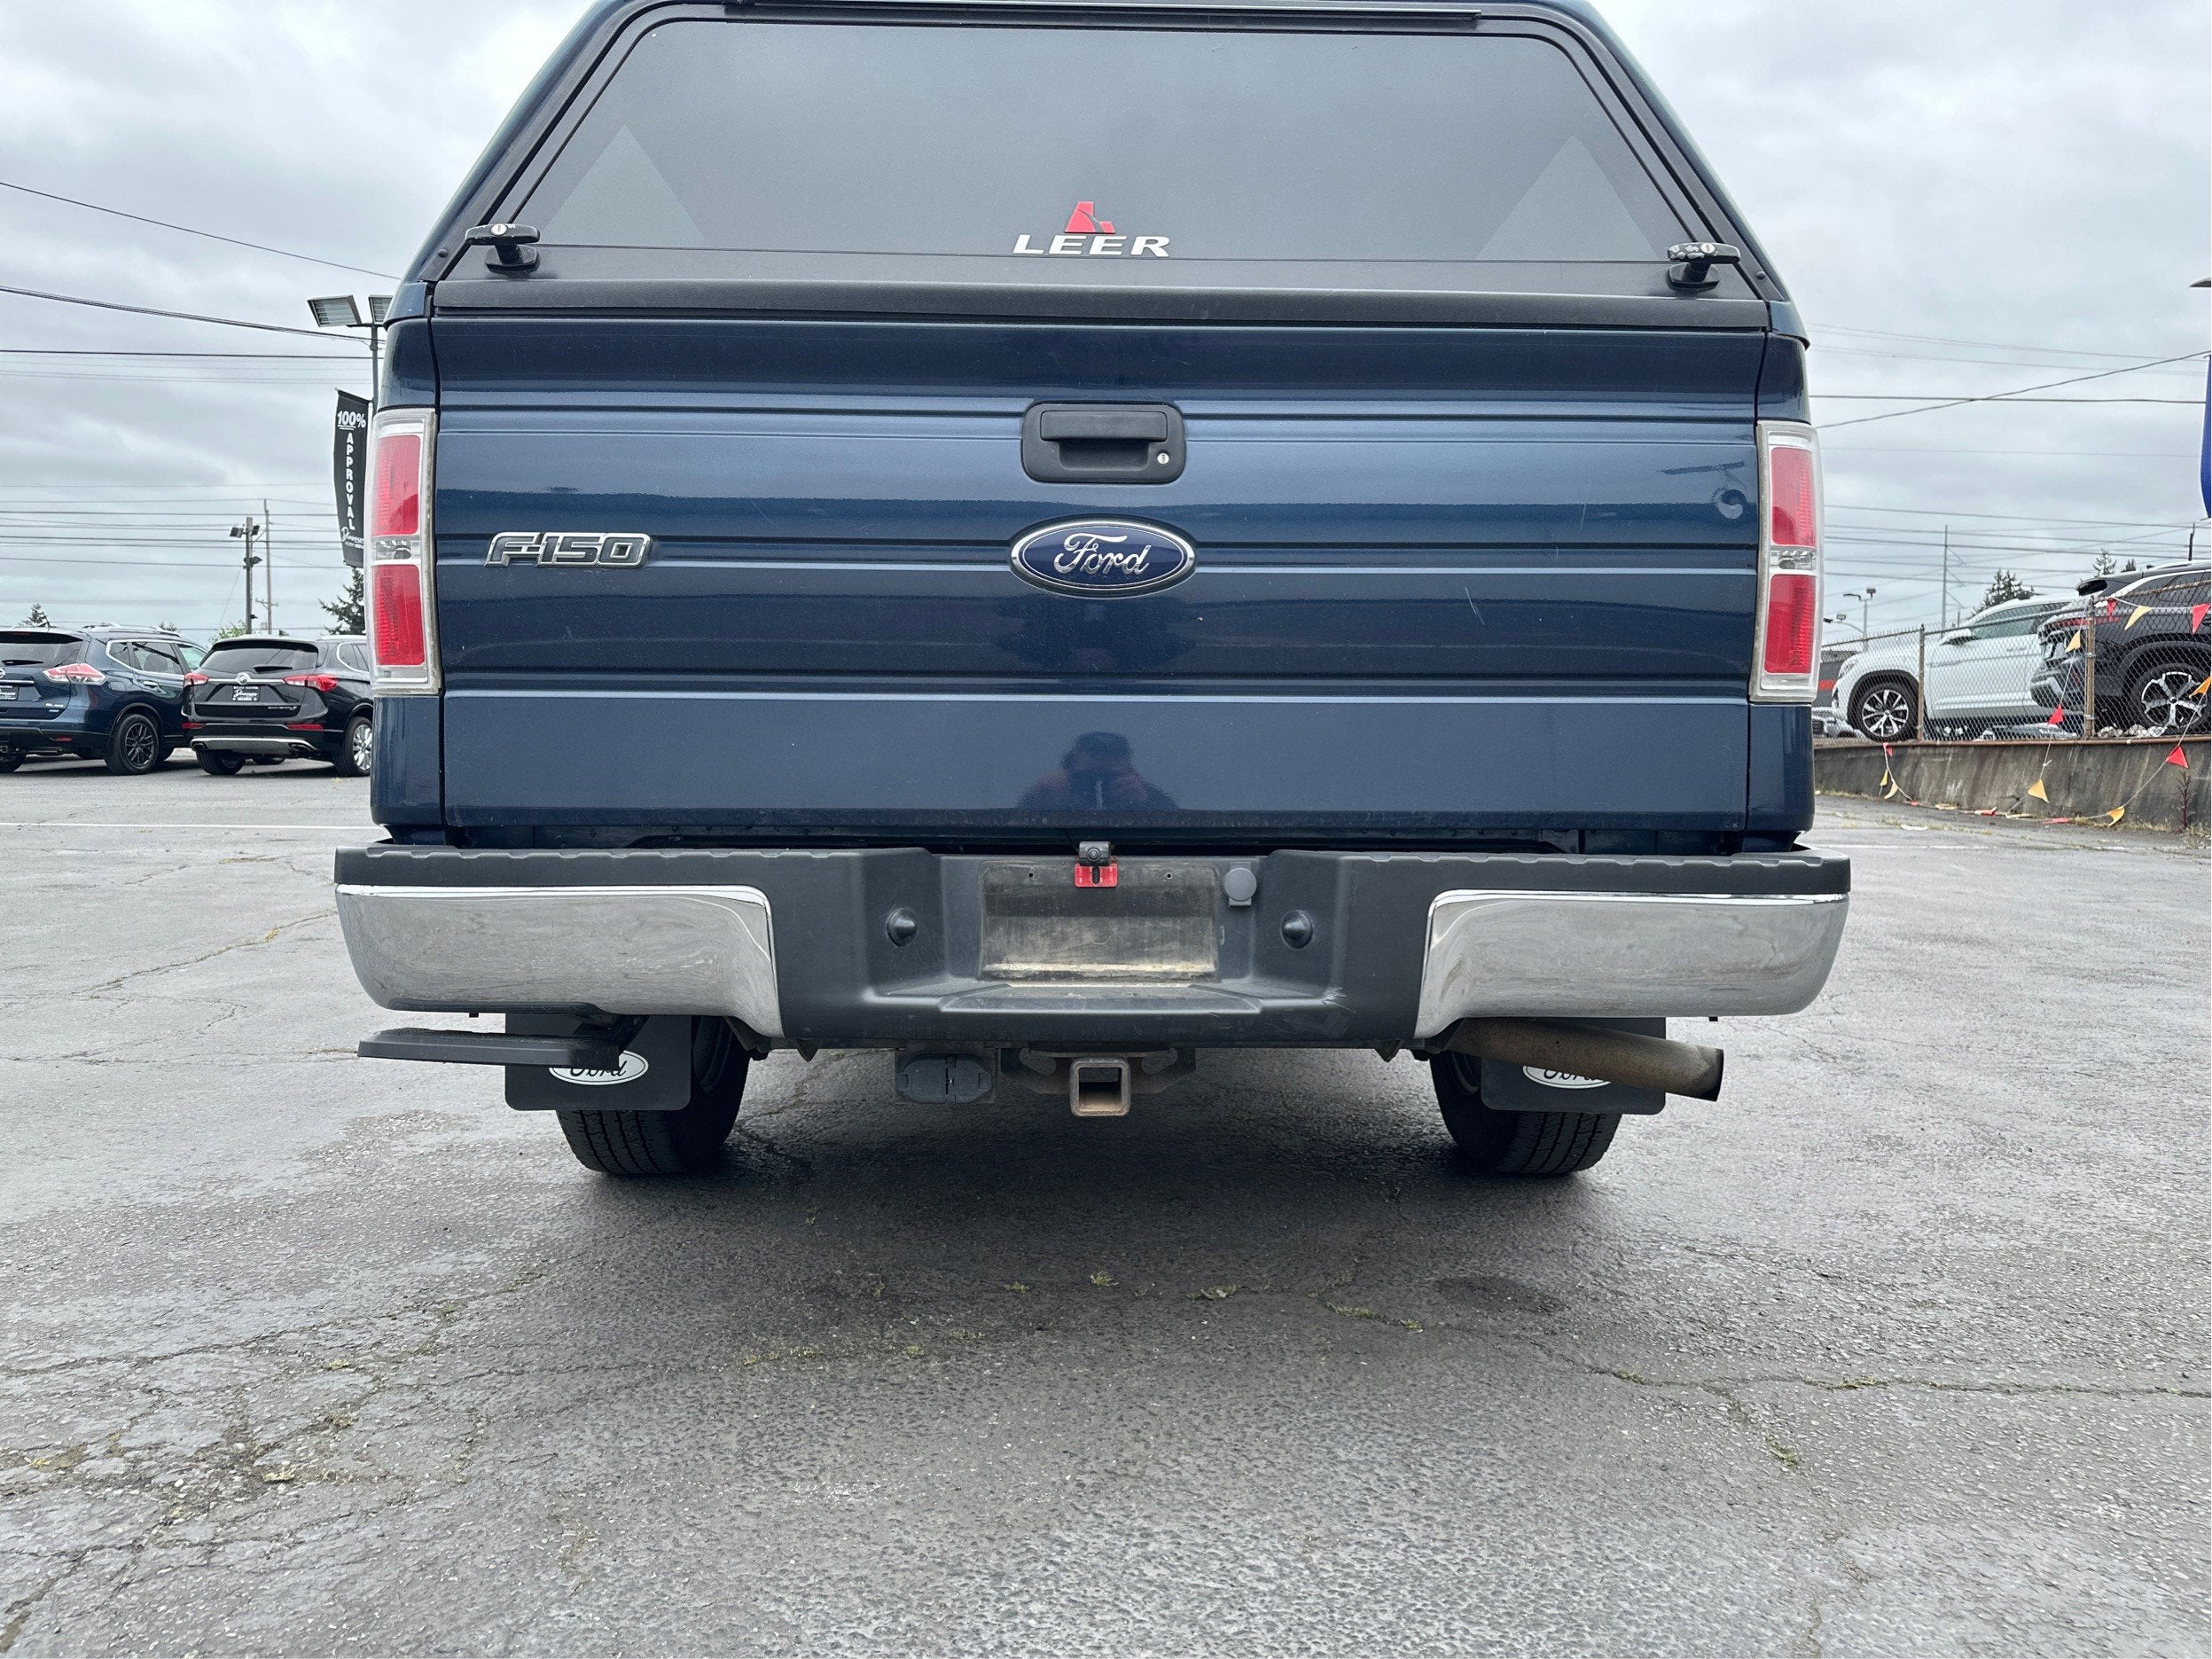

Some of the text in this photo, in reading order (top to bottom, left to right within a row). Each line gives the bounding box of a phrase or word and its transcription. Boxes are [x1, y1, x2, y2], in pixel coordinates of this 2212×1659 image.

[1012, 234, 1170, 257] LEER
[337, 411, 366, 428] 100%
[345, 432, 356, 530] APPROVAL
[1053, 532, 1152, 575] Ford
[569, 1060, 628, 1077] ord
